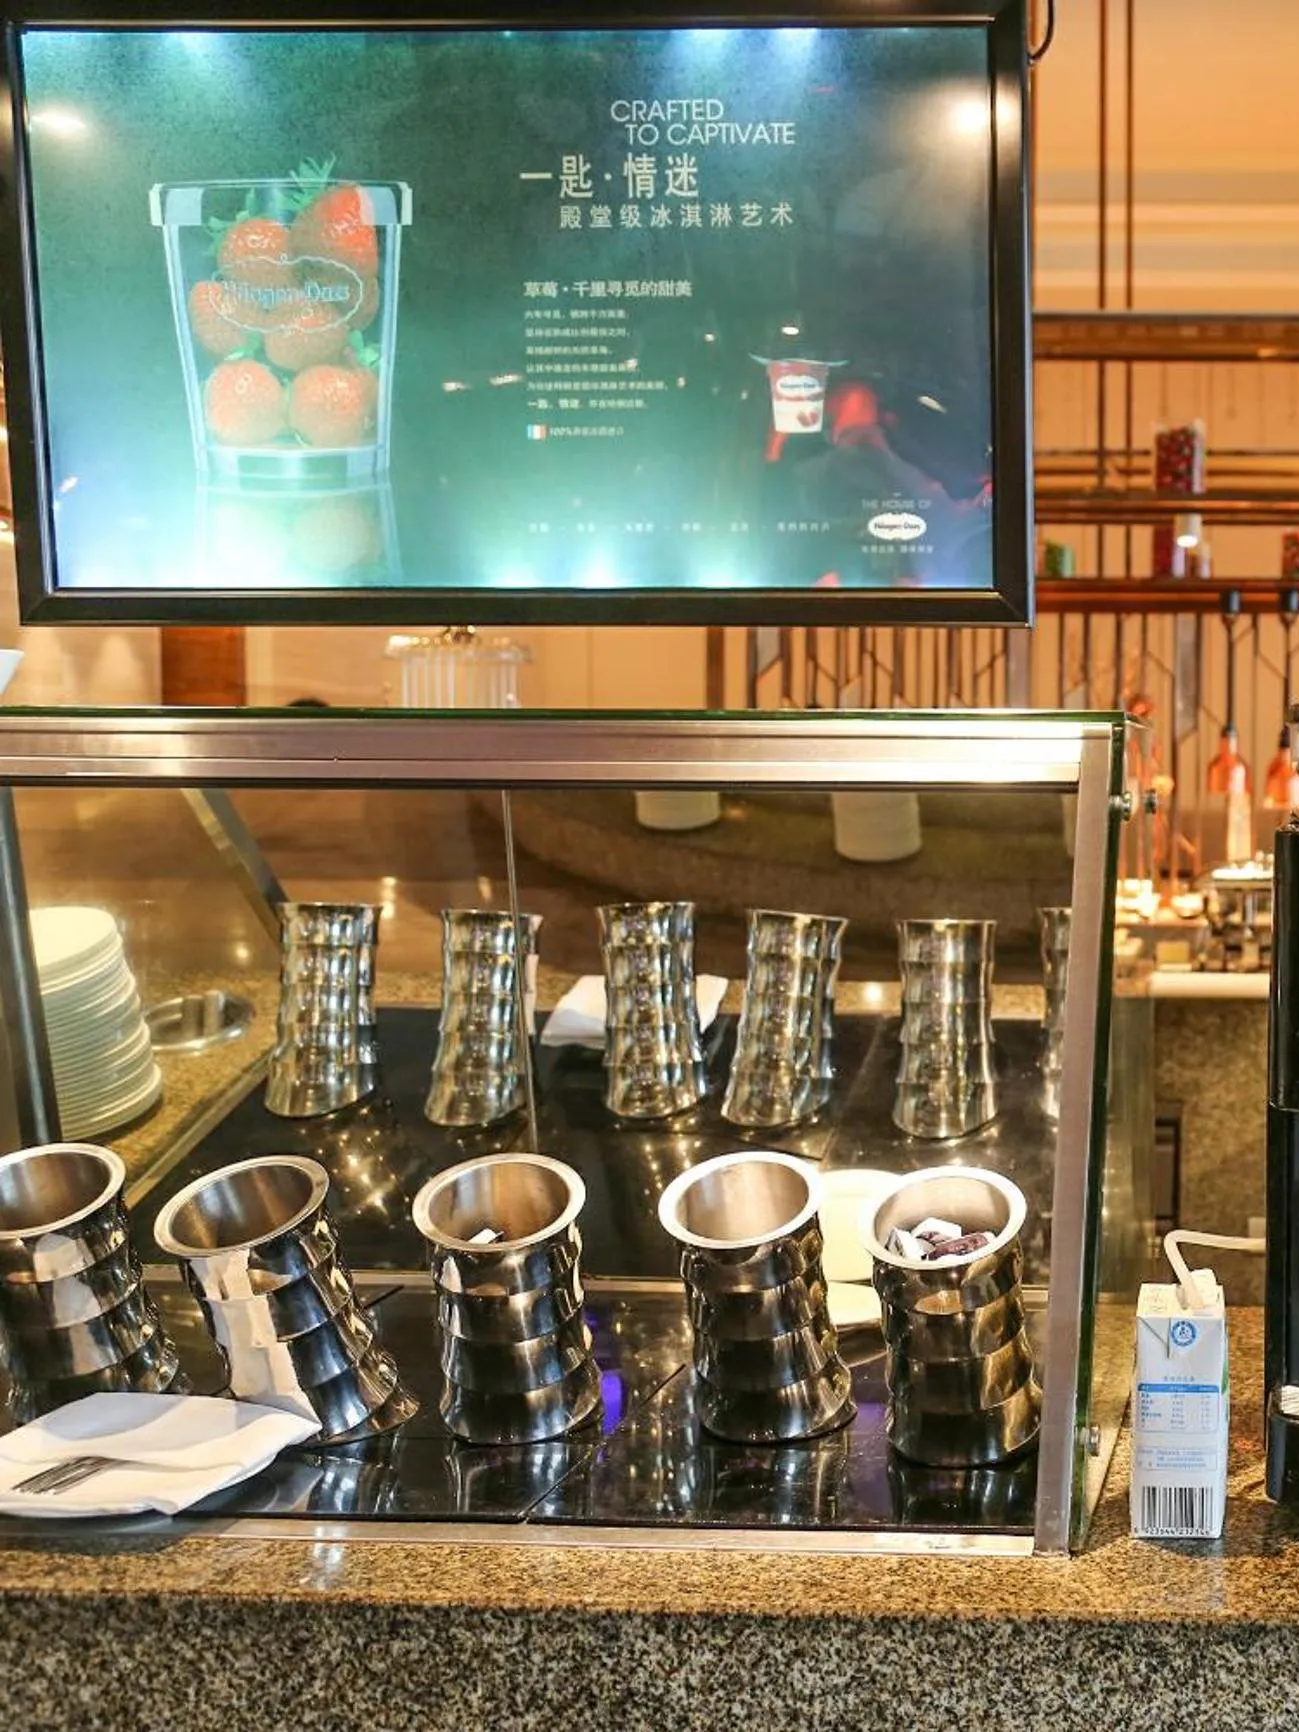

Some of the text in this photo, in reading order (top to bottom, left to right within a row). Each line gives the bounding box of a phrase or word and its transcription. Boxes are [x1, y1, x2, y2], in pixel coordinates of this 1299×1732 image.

[610, 99, 724, 122] CRAFTED
[625, 122, 796, 146] TO CAPTIVATE
[559, 202, 794, 229] 殿堂级冰淇淋艺术
